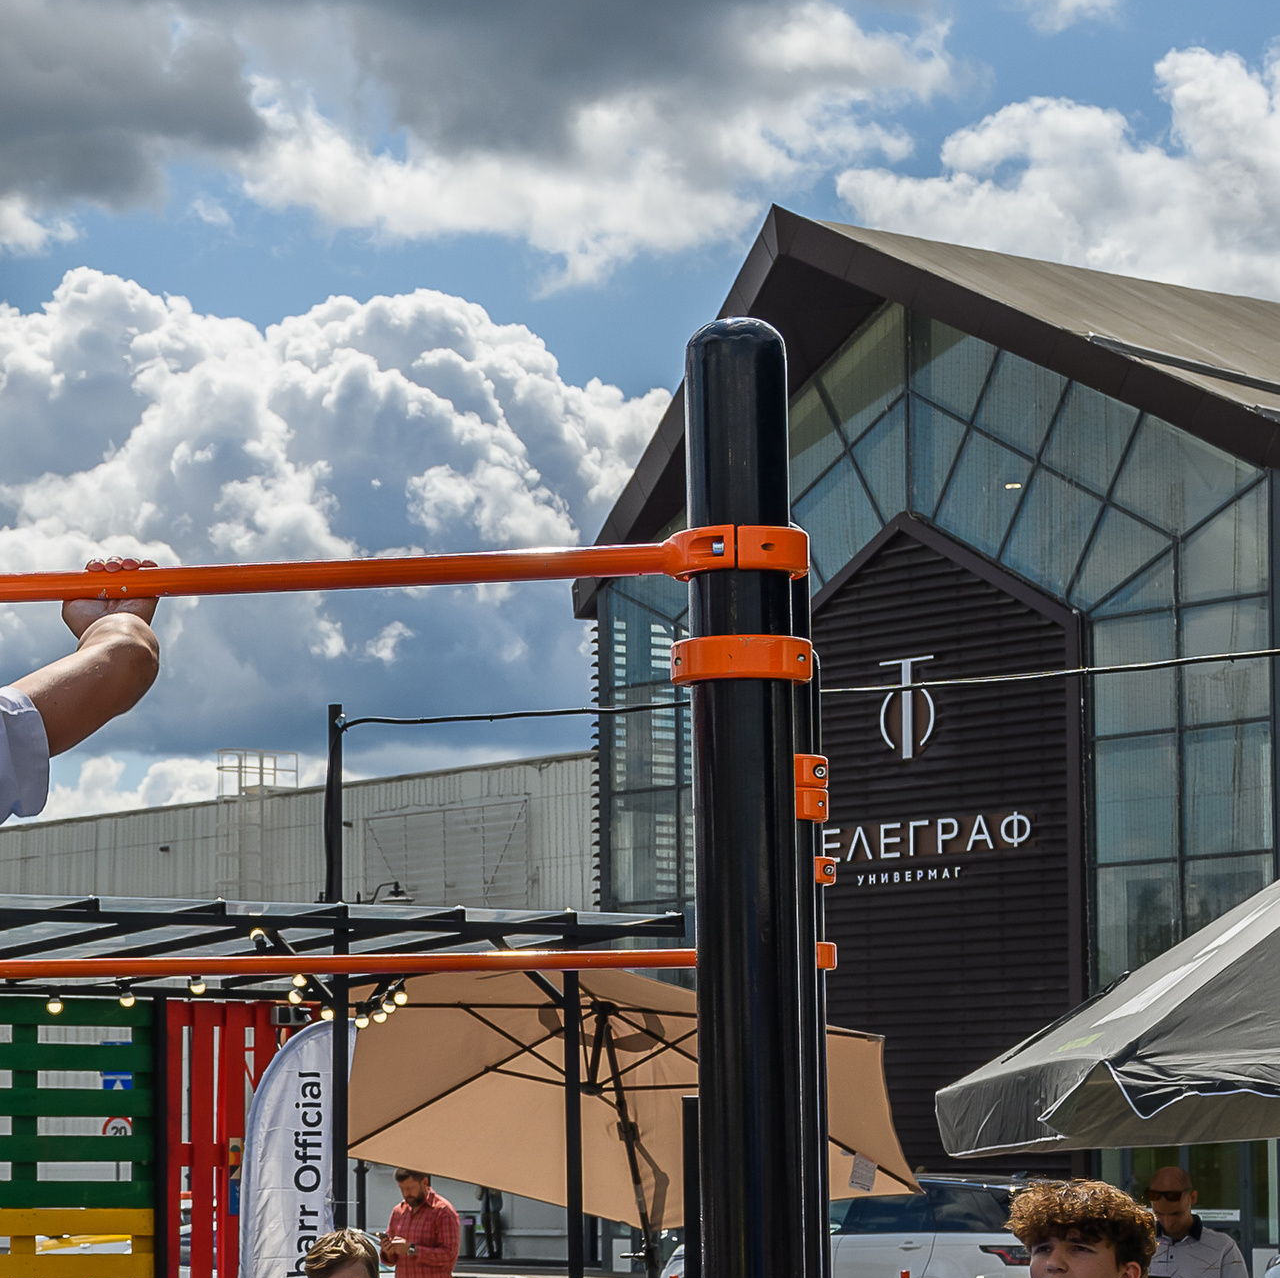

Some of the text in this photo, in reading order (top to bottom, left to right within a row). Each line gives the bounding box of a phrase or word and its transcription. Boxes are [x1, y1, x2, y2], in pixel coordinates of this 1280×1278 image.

[823, 811, 1031, 863] ЕЛЕГРАФ
[857, 866, 961, 886] УНИВЕРМАГ
[294, 1071, 323, 1193] Official
